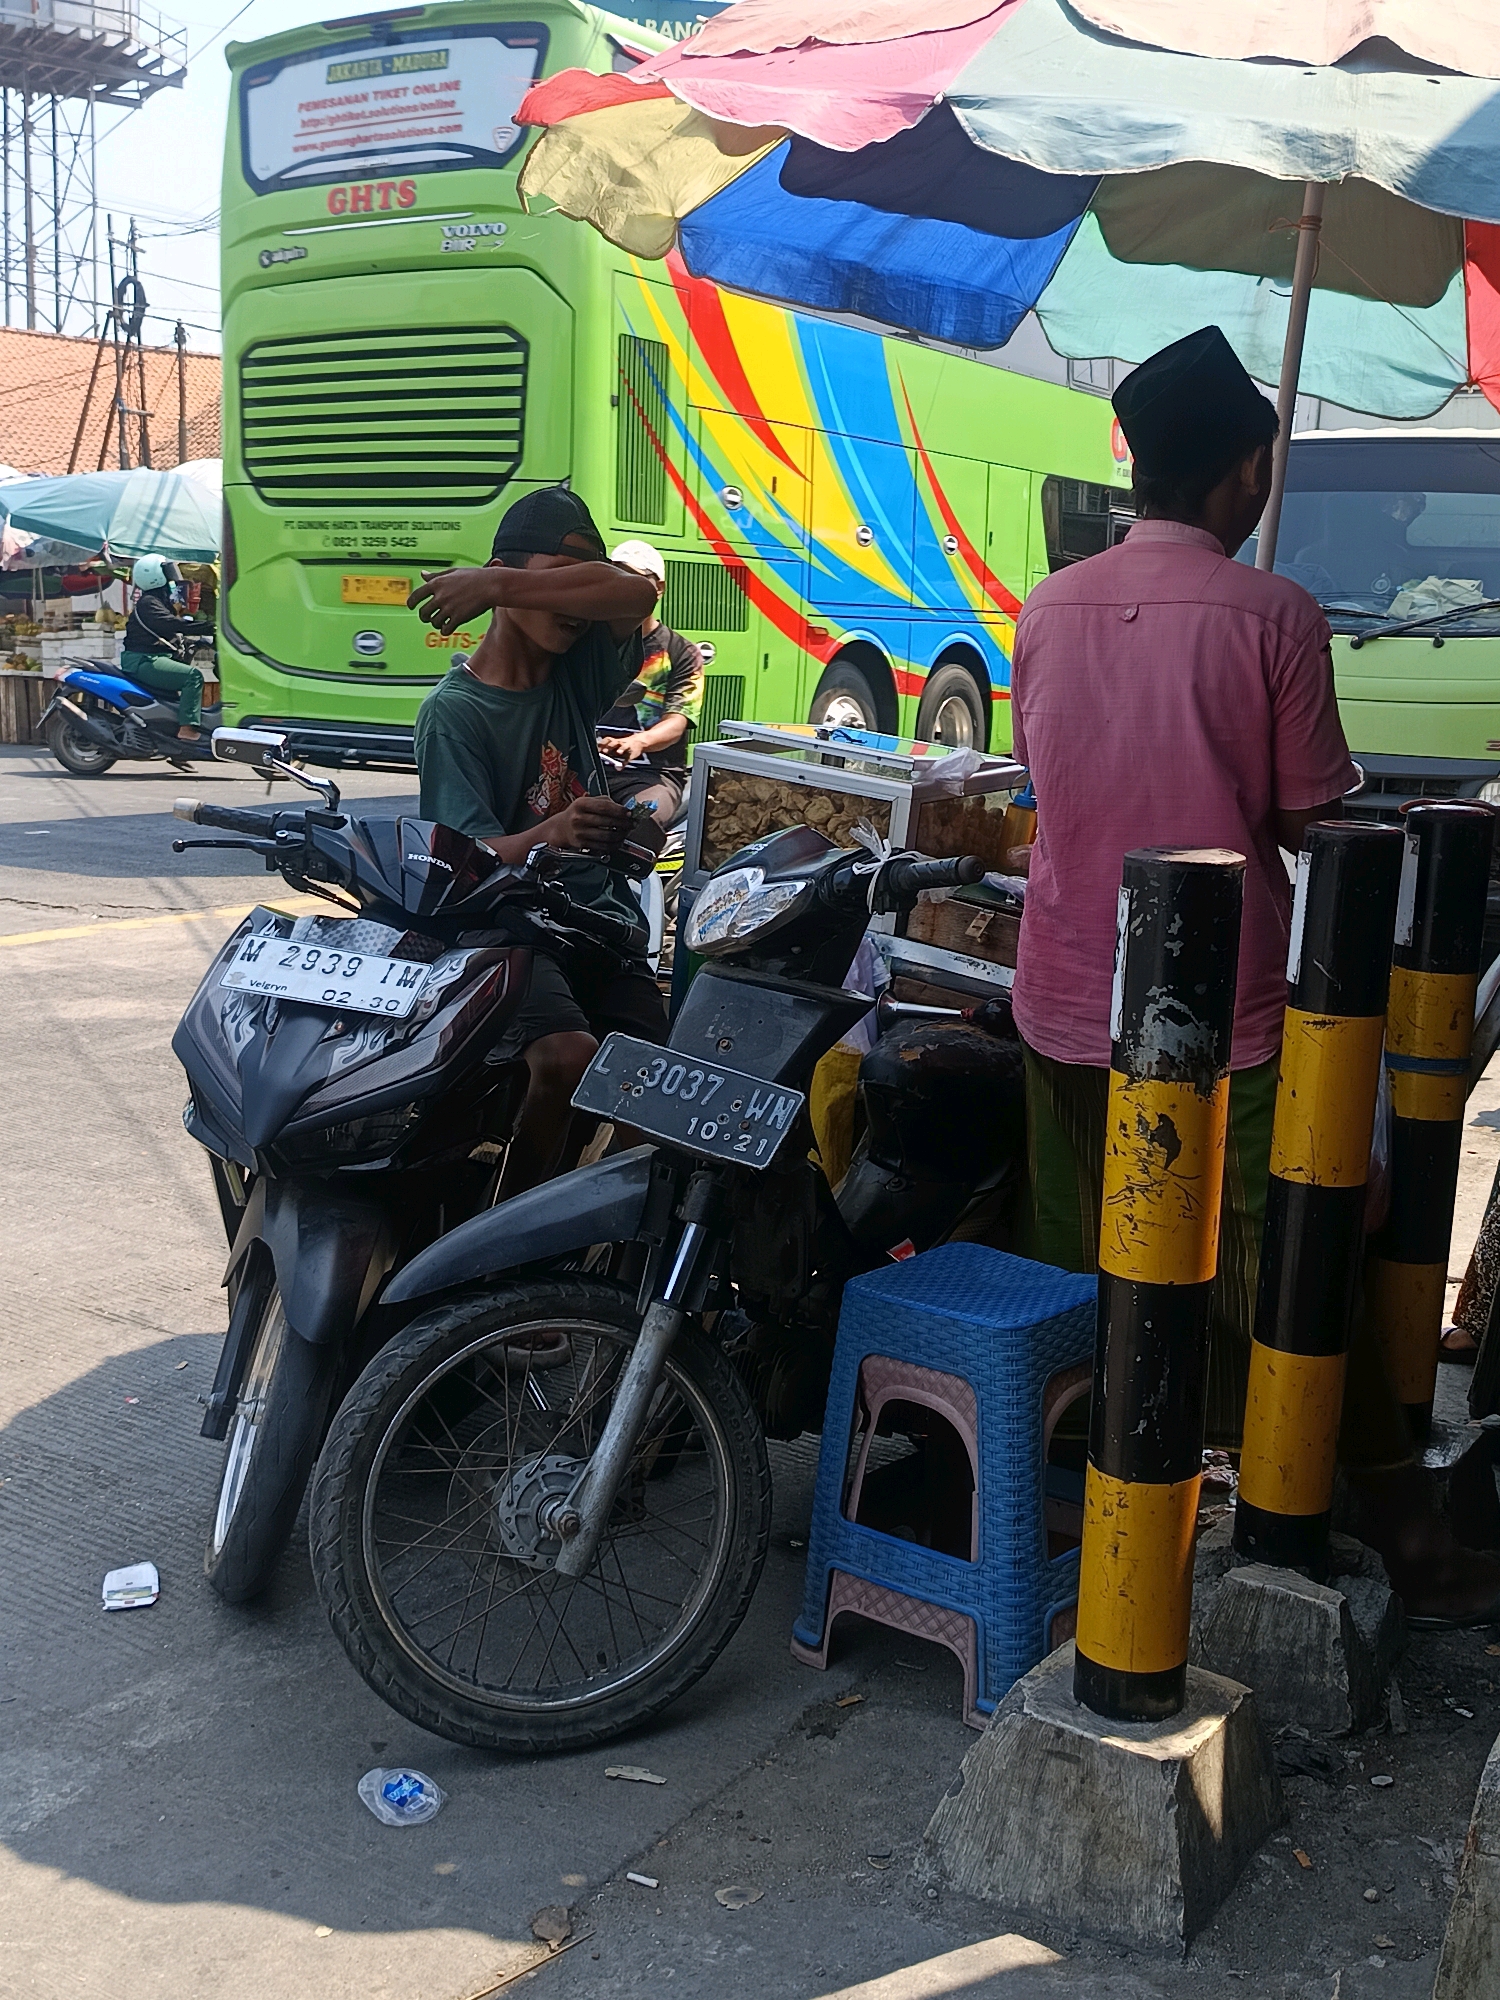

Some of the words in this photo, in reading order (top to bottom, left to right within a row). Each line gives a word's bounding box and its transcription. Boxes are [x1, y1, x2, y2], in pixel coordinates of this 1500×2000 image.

[328, 59, 383, 82] JAKARTA
[392, 51, 447, 73] MADURA
[297, 92, 369, 112] PEMESANAN
[372, 87, 409, 100] TIKET
[412, 80, 461, 95] ONLINE
[327, 180, 416, 215] GHTS
[440, 223, 507, 238] VOLVO
[297, 521, 330, 530] GUNUNG
[332, 521, 359, 530] HARTA
[360, 521, 409, 530] TRANSPORT
[411, 521, 461, 531] SOLUTIONS
[333, 537, 358, 547] 0821
[361, 537, 387, 547] 3259
[390, 537, 418, 547] 5425
[407, 853, 453, 872] HONDA
[240, 939, 267, 962] M
[278, 945, 364, 978] 2939
[380, 963, 423, 989] IM
[249, 979, 288, 992] Velgryn
[594, 1043, 615, 1075] L
[643, 1057, 725, 1105] 3037
[745, 1089, 796, 1130] WN
